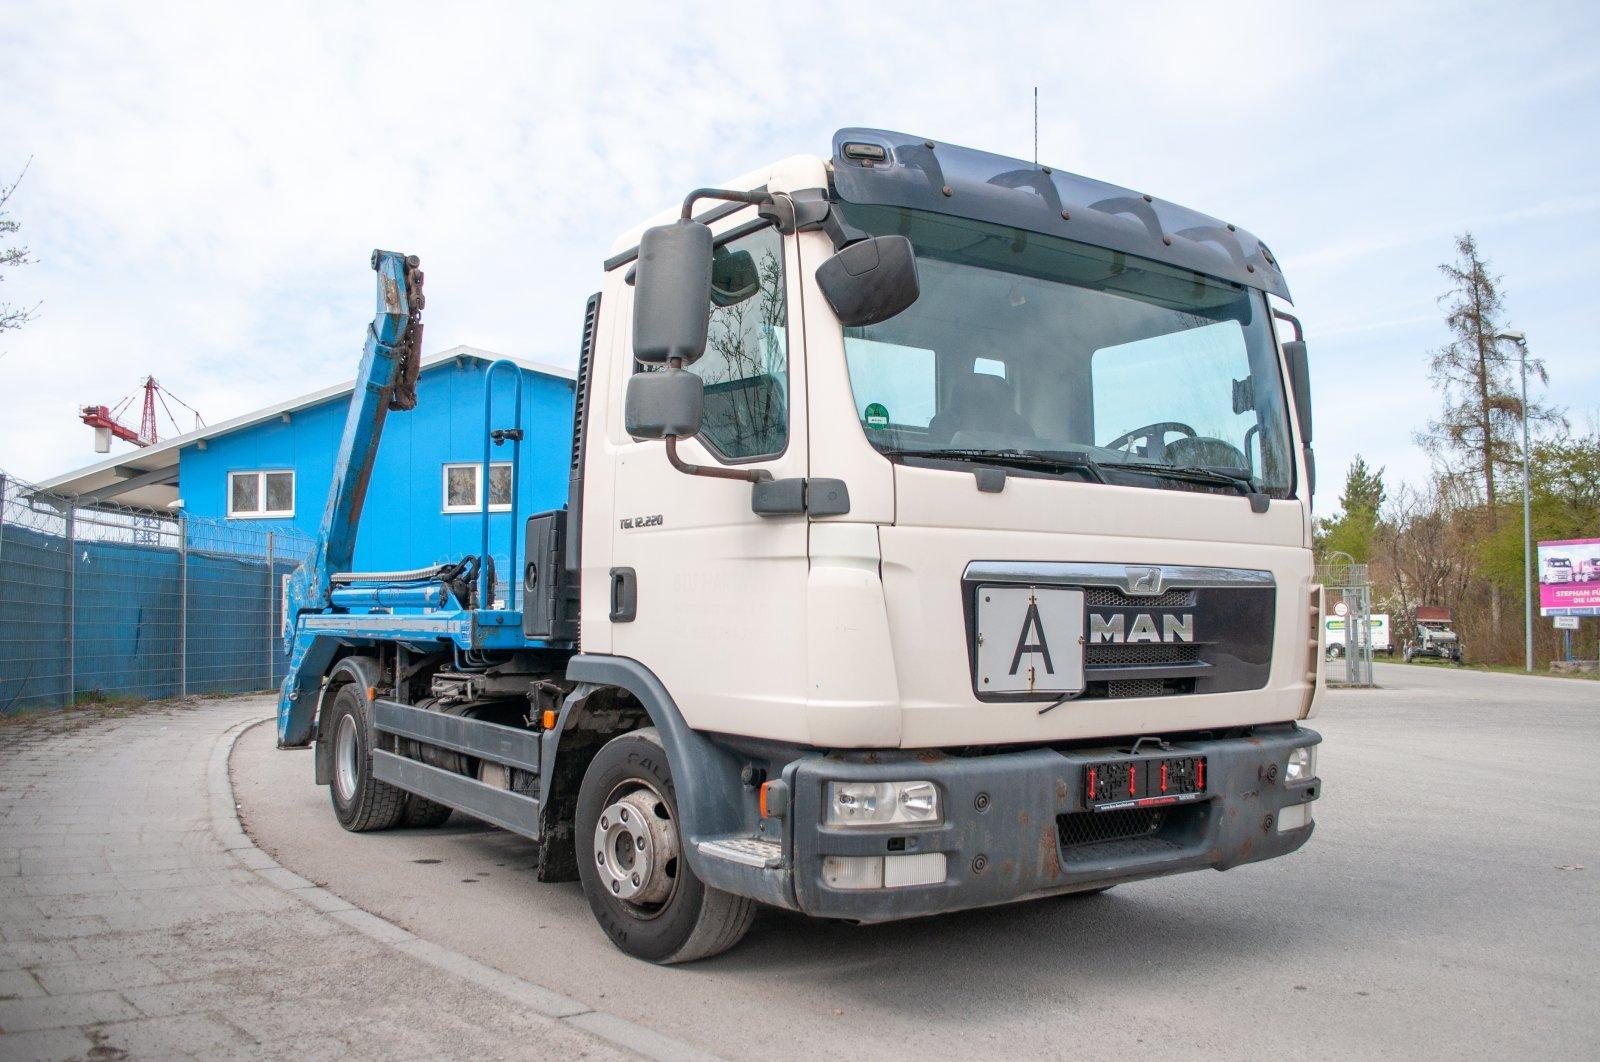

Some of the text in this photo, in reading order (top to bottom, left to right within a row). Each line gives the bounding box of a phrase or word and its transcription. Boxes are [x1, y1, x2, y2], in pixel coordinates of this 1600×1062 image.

[619, 518, 634, 529] TGL
[1008, 603, 1055, 675] A
[1090, 613, 1193, 643] MAN
